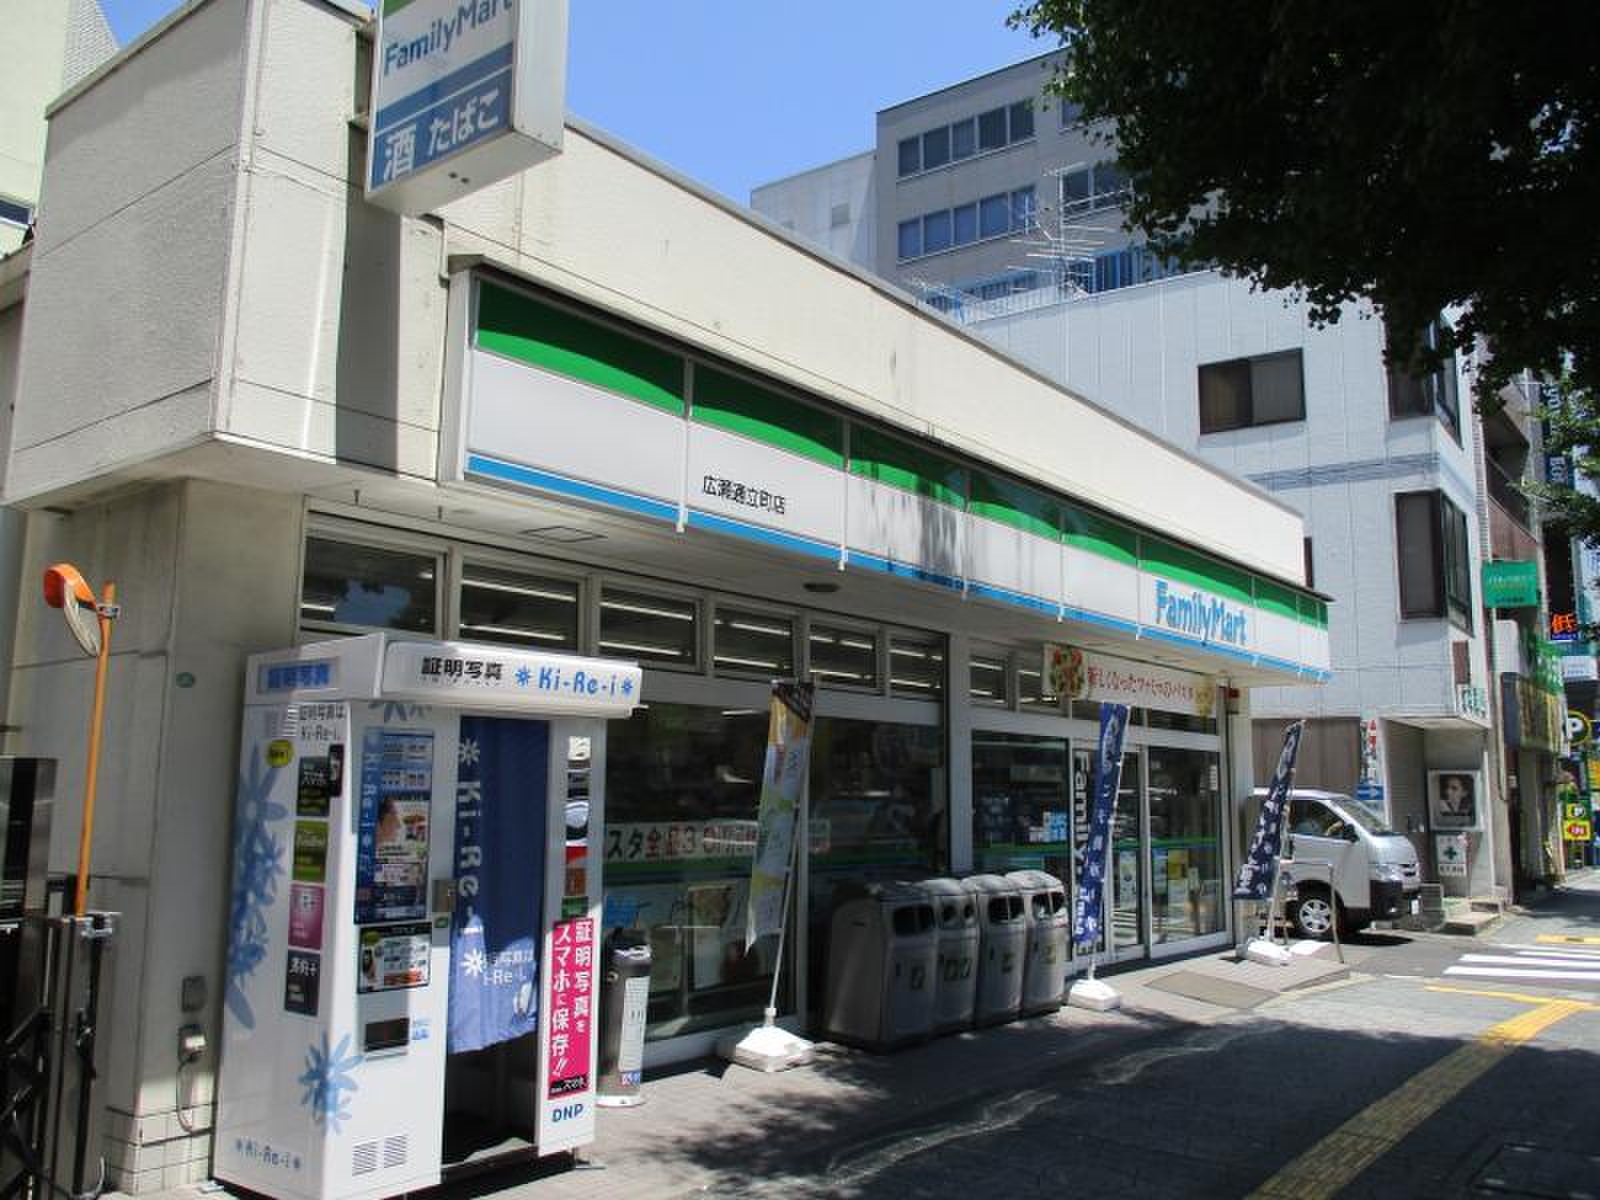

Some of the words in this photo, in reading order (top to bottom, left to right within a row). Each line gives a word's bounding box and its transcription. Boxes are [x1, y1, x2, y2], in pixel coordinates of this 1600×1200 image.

[384, 125, 416, 182] 酒
[429, 88, 498, 157] たばこ
[1155, 579, 1248, 646] FamilyMart
[422, 657, 503, 680] 証明写真
[539, 665, 617, 696] Ki-Re-i
[573, 921, 592, 1034] 証明写真を
[552, 1103, 585, 1123] DNP
